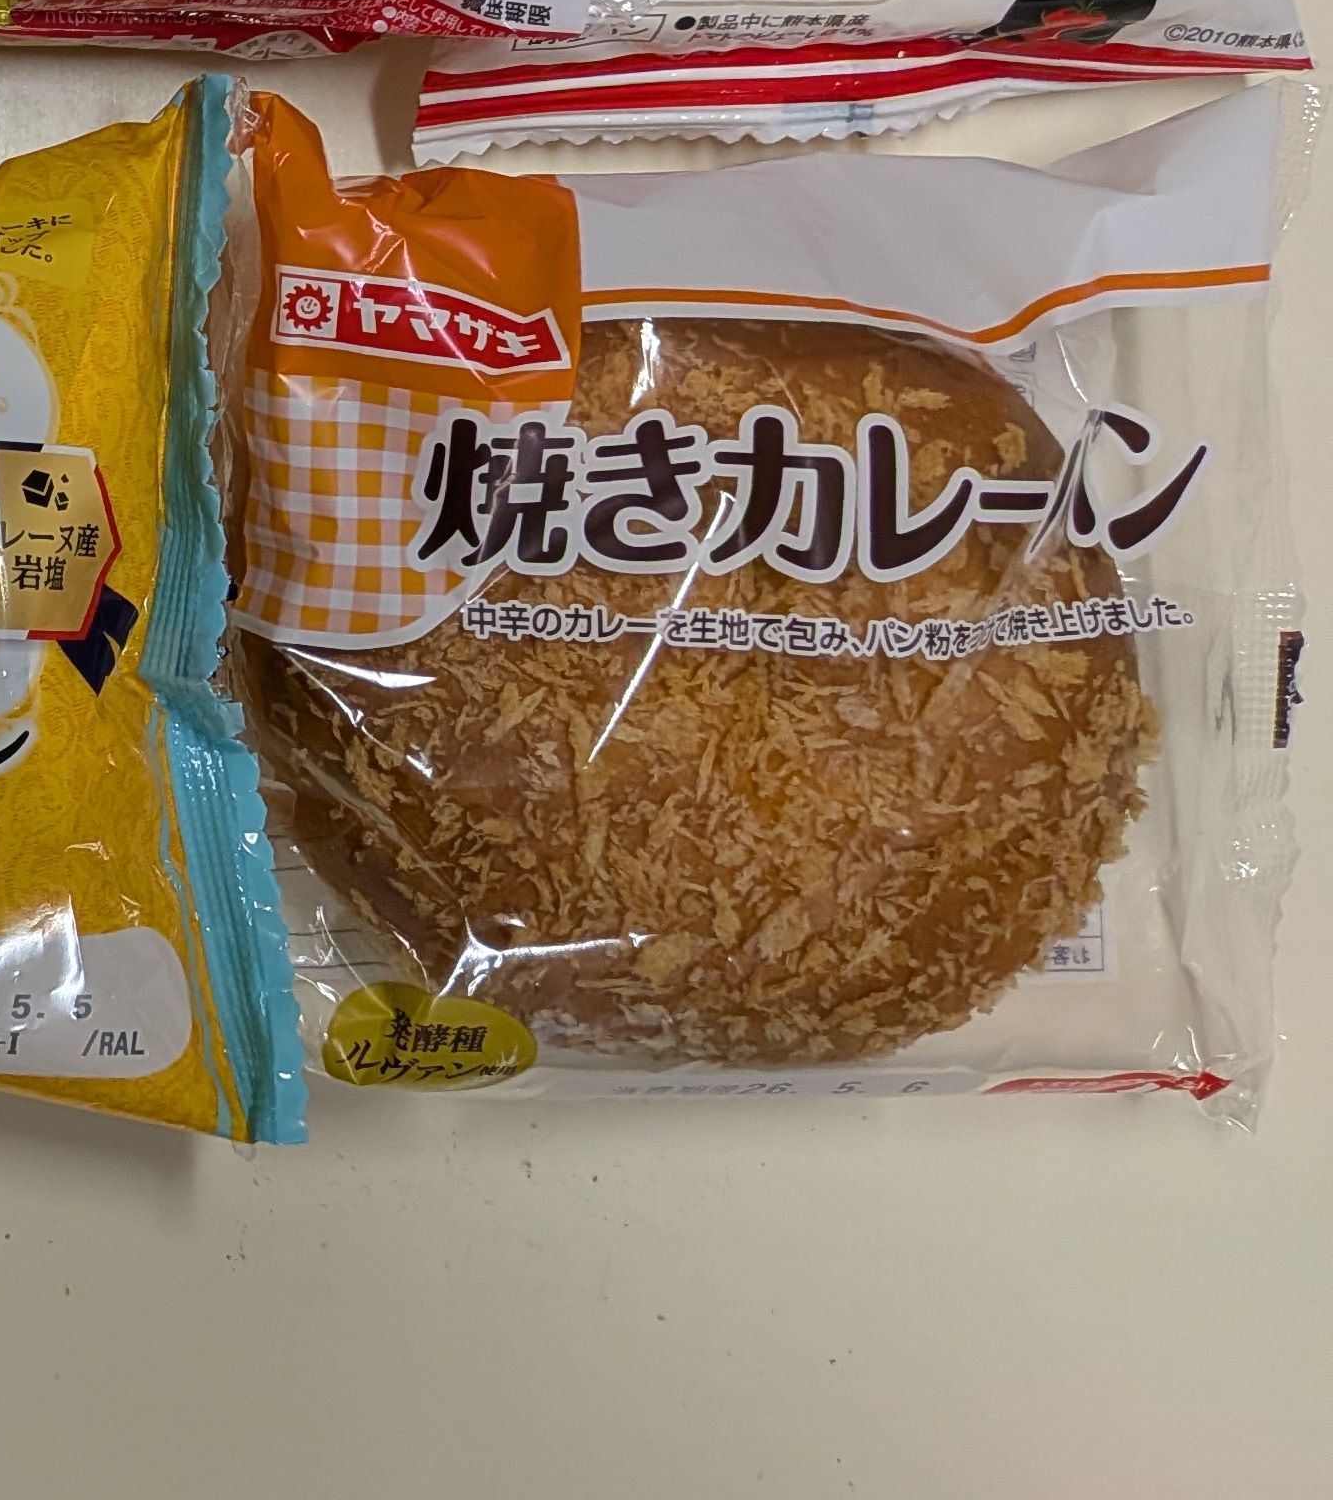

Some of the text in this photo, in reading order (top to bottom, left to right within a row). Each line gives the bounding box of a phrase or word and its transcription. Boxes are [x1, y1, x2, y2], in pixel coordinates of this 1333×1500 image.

[353, 296, 541, 358] ヤマザキ
[10, 554, 67, 591] 岩塩
[384, 1007, 488, 1055] 発酵種
